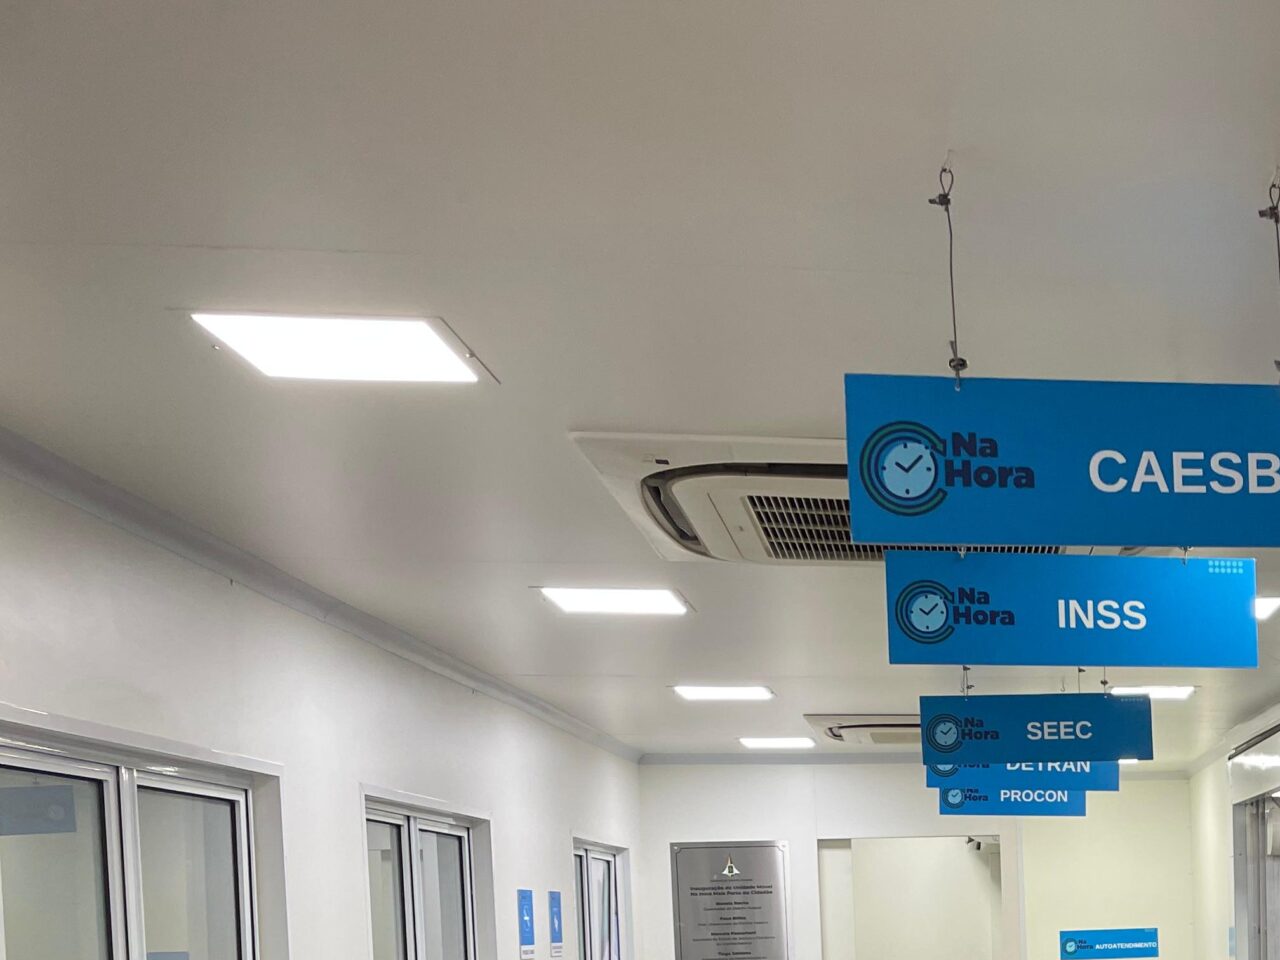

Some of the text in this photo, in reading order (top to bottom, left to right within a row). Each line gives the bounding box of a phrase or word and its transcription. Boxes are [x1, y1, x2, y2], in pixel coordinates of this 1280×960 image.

[951, 432, 998, 458] Na
[944, 460, 1035, 489] Hora
[958, 587, 990, 605] Na
[953, 606, 1015, 626] Hora
[1057, 599, 1147, 630] INSS
[964, 717, 984, 728] Na
[1026, 721, 1093, 740] SEEC
[960, 728, 1000, 740] Hora
[964, 793, 989, 801] Hora
[1000, 789, 1068, 802] PROCON
